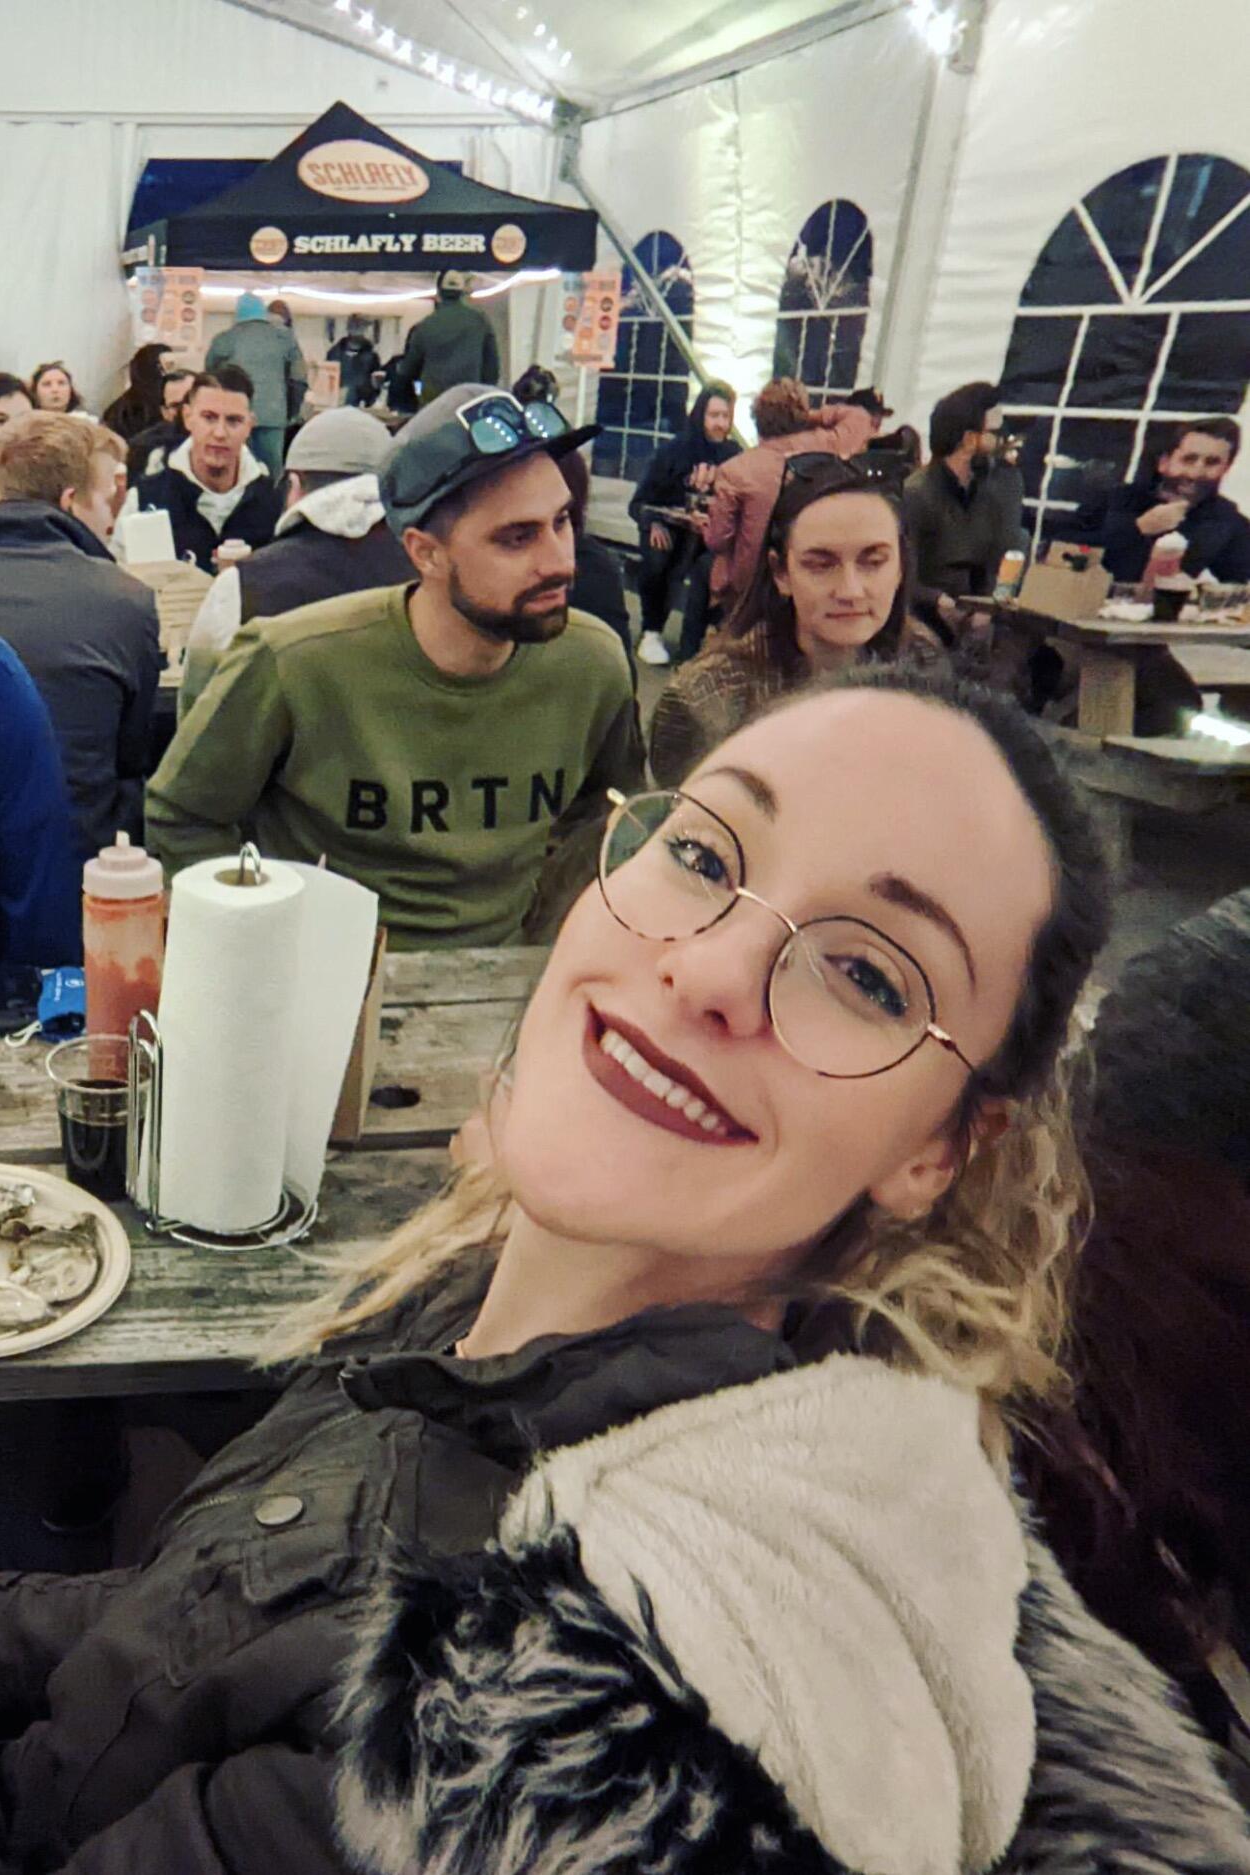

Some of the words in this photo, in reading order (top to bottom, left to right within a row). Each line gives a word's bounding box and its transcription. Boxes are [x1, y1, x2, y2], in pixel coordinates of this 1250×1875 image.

[307, 161, 419, 186] SCHLAFLY
[294, 234, 417, 253] SCHLAFLY
[422, 233, 486, 253] BEER
[346, 768, 565, 833] BRTN
